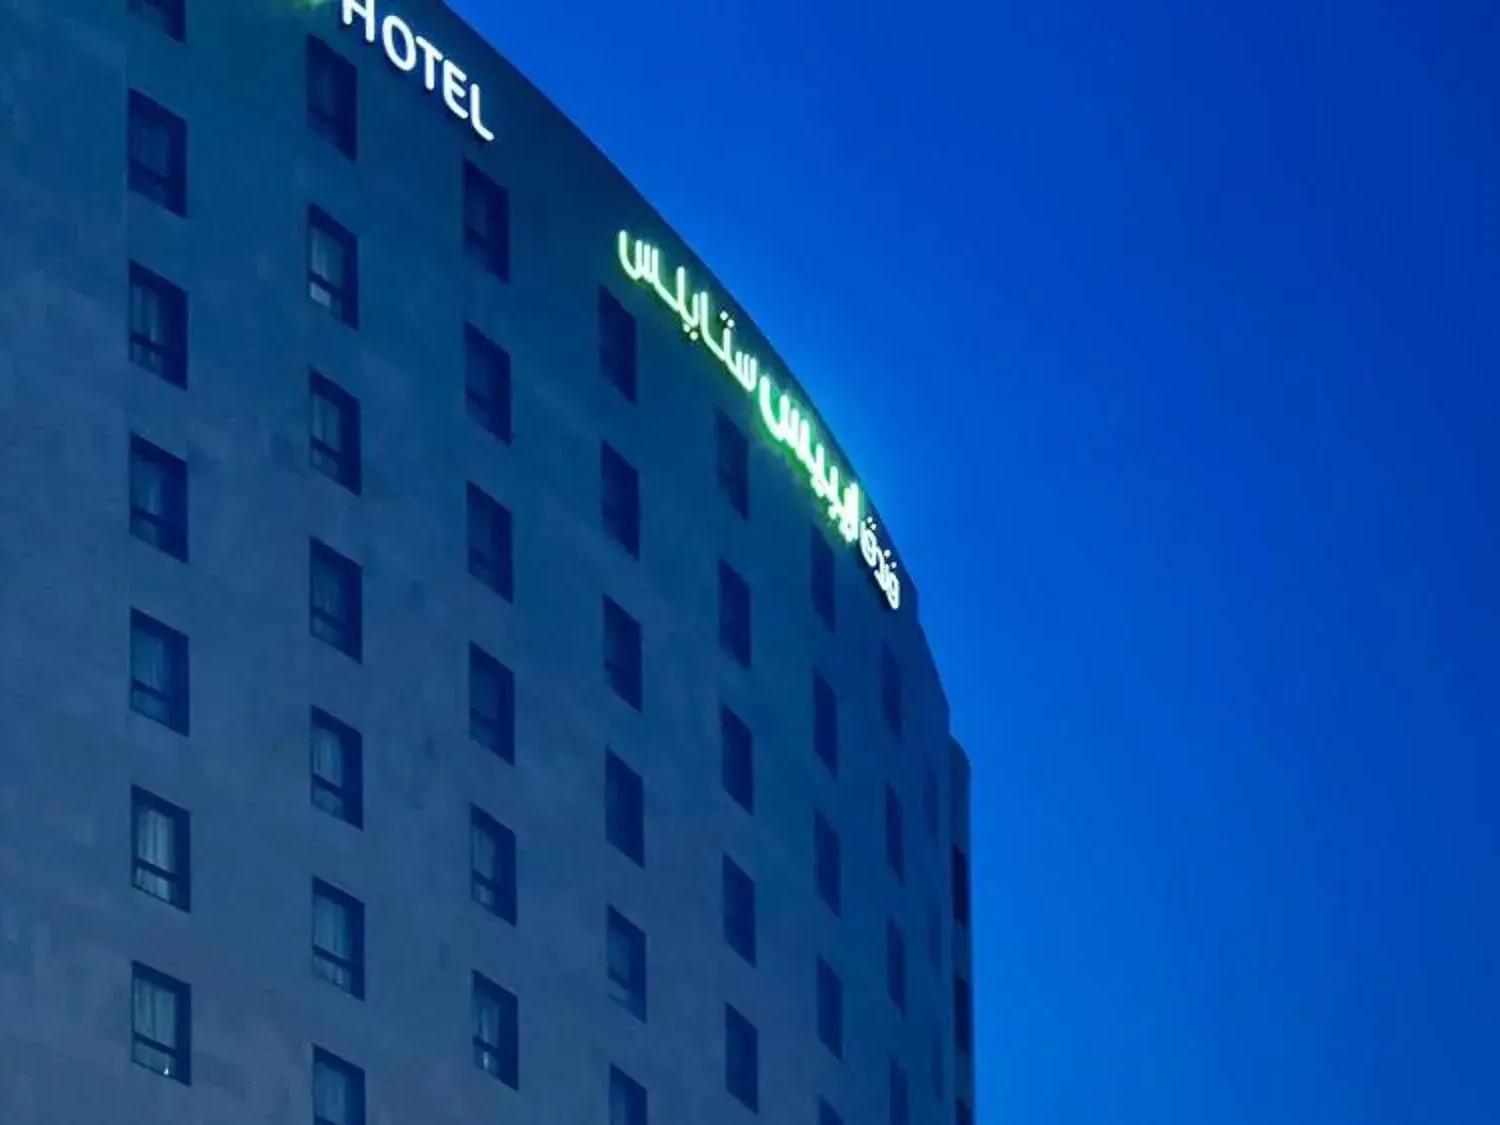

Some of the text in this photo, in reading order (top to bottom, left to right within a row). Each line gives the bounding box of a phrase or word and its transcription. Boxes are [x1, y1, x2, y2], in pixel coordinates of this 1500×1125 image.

[341, 0, 494, 141] HOTEL
[618, 229, 757, 392] ستايلس
[861, 516, 900, 609] فندق
